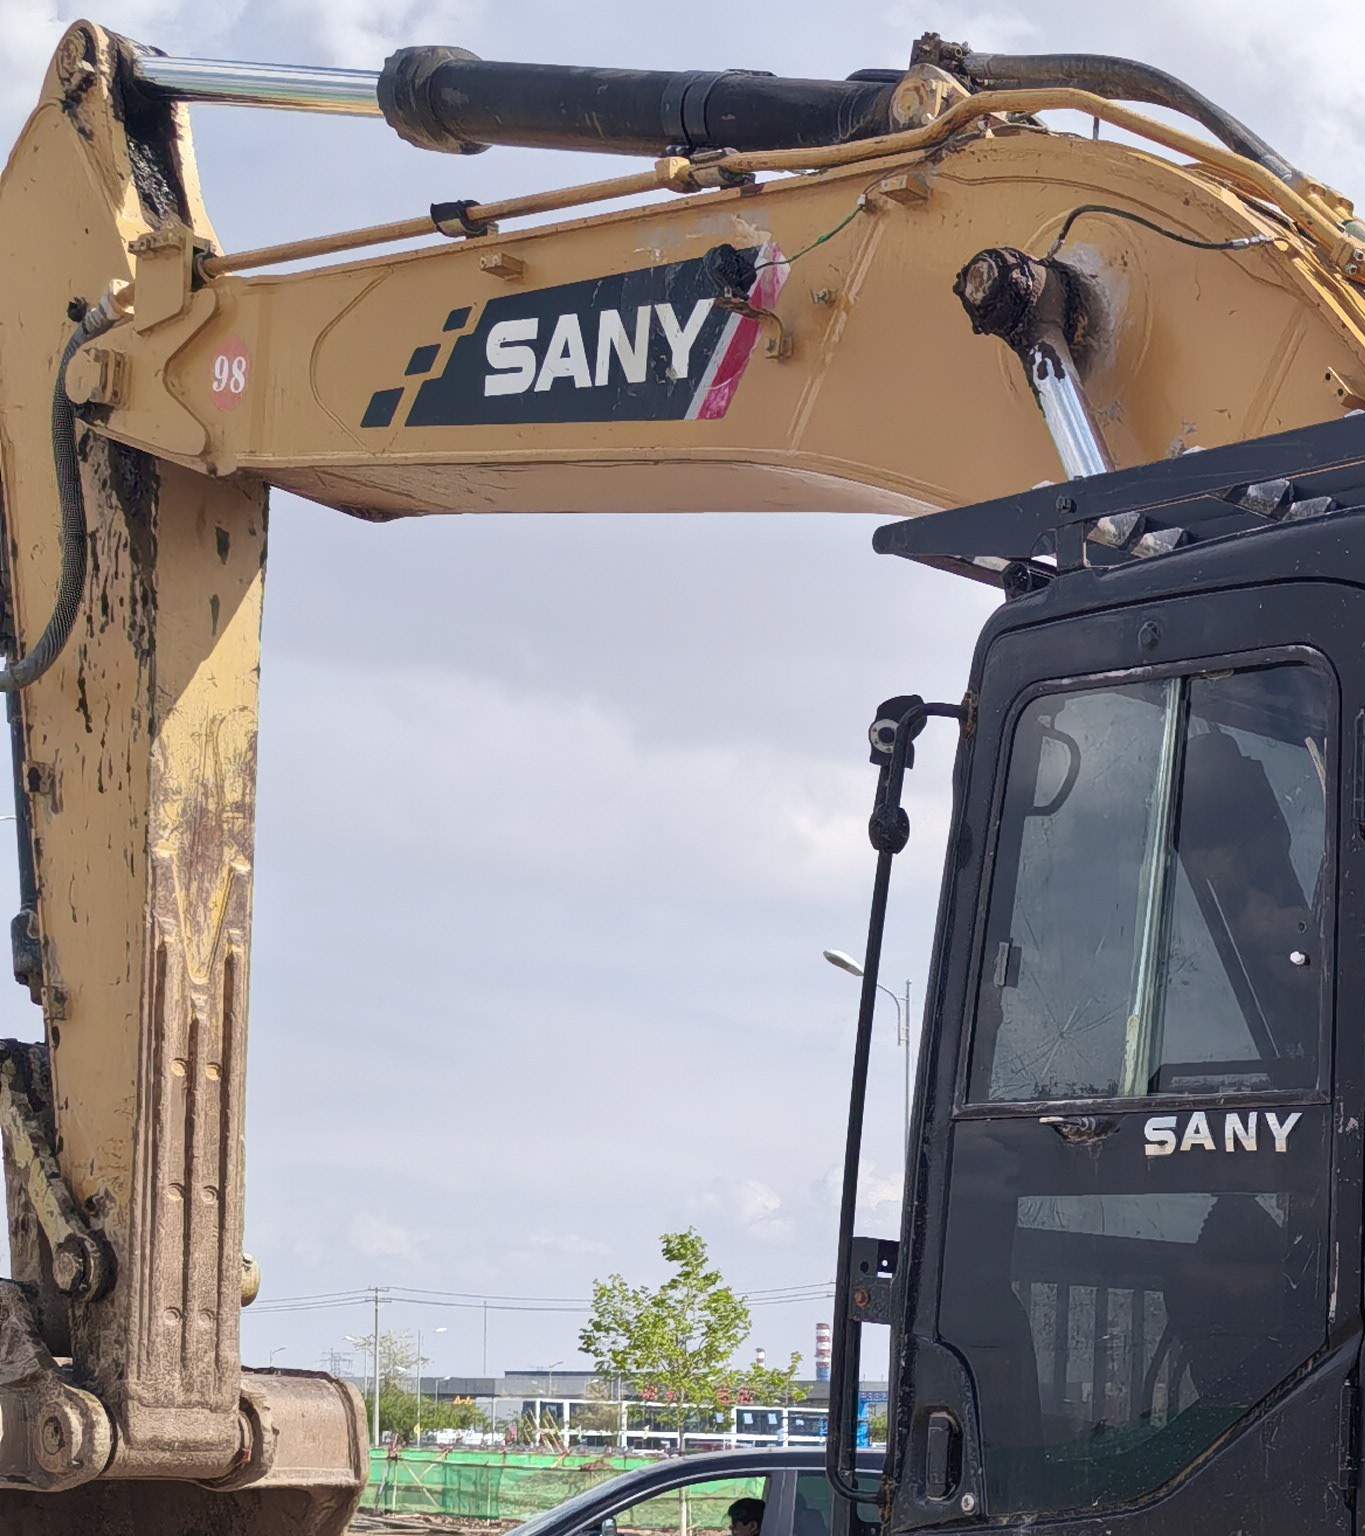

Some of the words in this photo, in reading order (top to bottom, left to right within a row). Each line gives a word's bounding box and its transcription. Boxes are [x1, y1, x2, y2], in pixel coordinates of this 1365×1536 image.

[484, 297, 715, 397] SANY
[211, 355, 247, 395] 98
[1143, 1111, 1303, 1156] SANY
